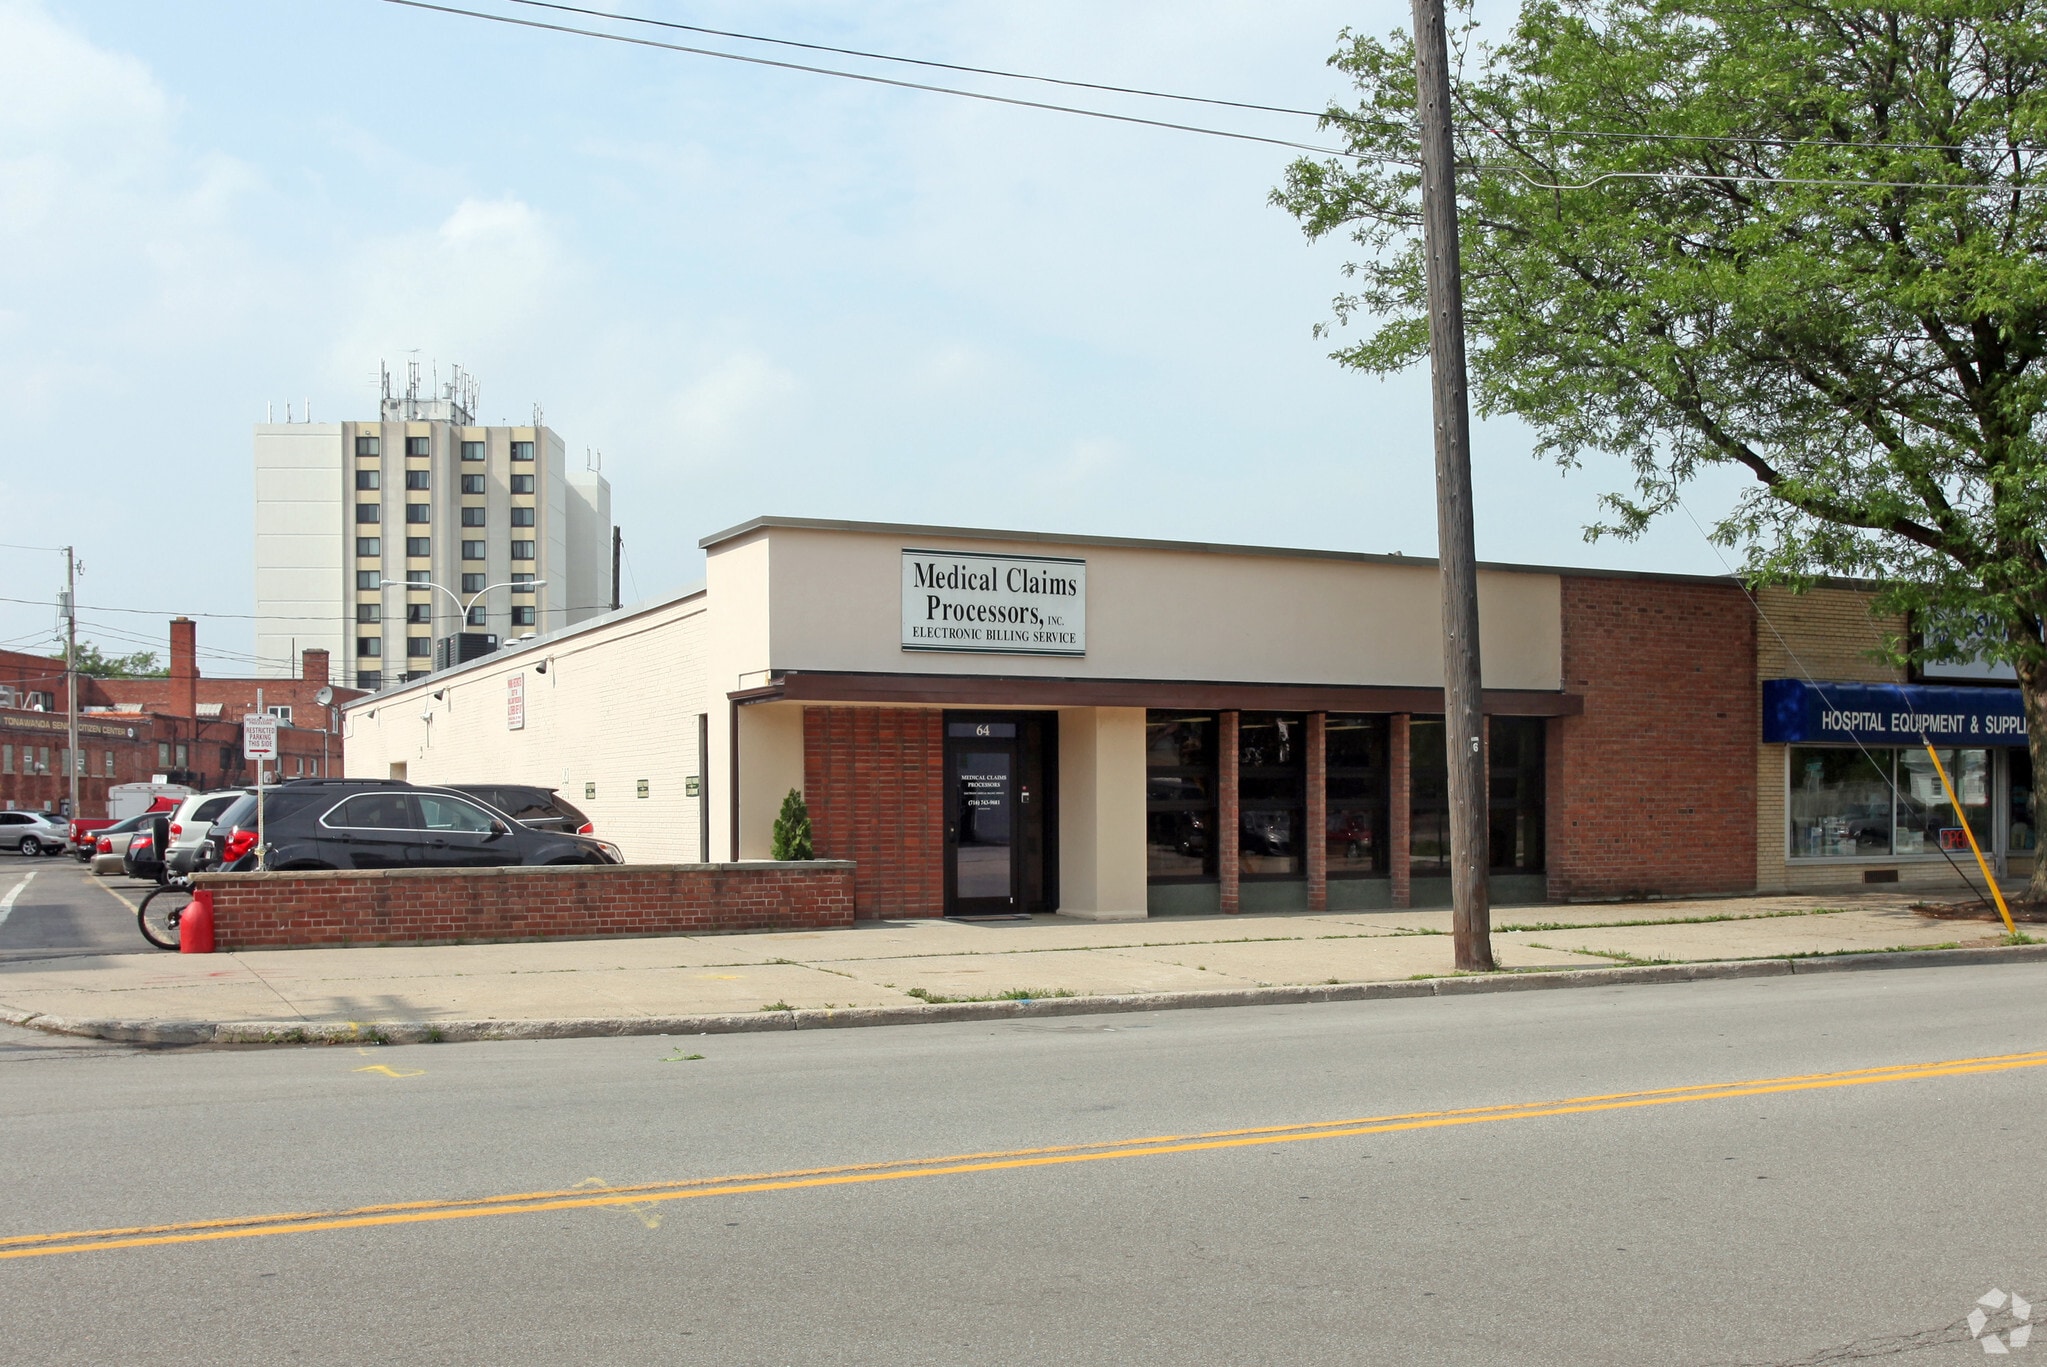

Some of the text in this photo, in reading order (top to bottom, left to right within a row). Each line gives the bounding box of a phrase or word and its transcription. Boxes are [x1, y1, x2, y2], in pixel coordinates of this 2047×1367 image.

[913, 562, 1077, 596] Medical Claims
[926, 594, 1065, 630] Processors, INC.
[912, 626, 1076, 644] ELECTRONIC BILLING SERVICE
[4, 716, 50, 729] TONAWANDA
[78, 723, 101, 733] CITIZEN
[102, 725, 126, 736] CENTER
[976, 724, 990, 737] 64
[1822, 710, 2028, 735] HOSPITAL EQUIPMENT & SUPPLI
